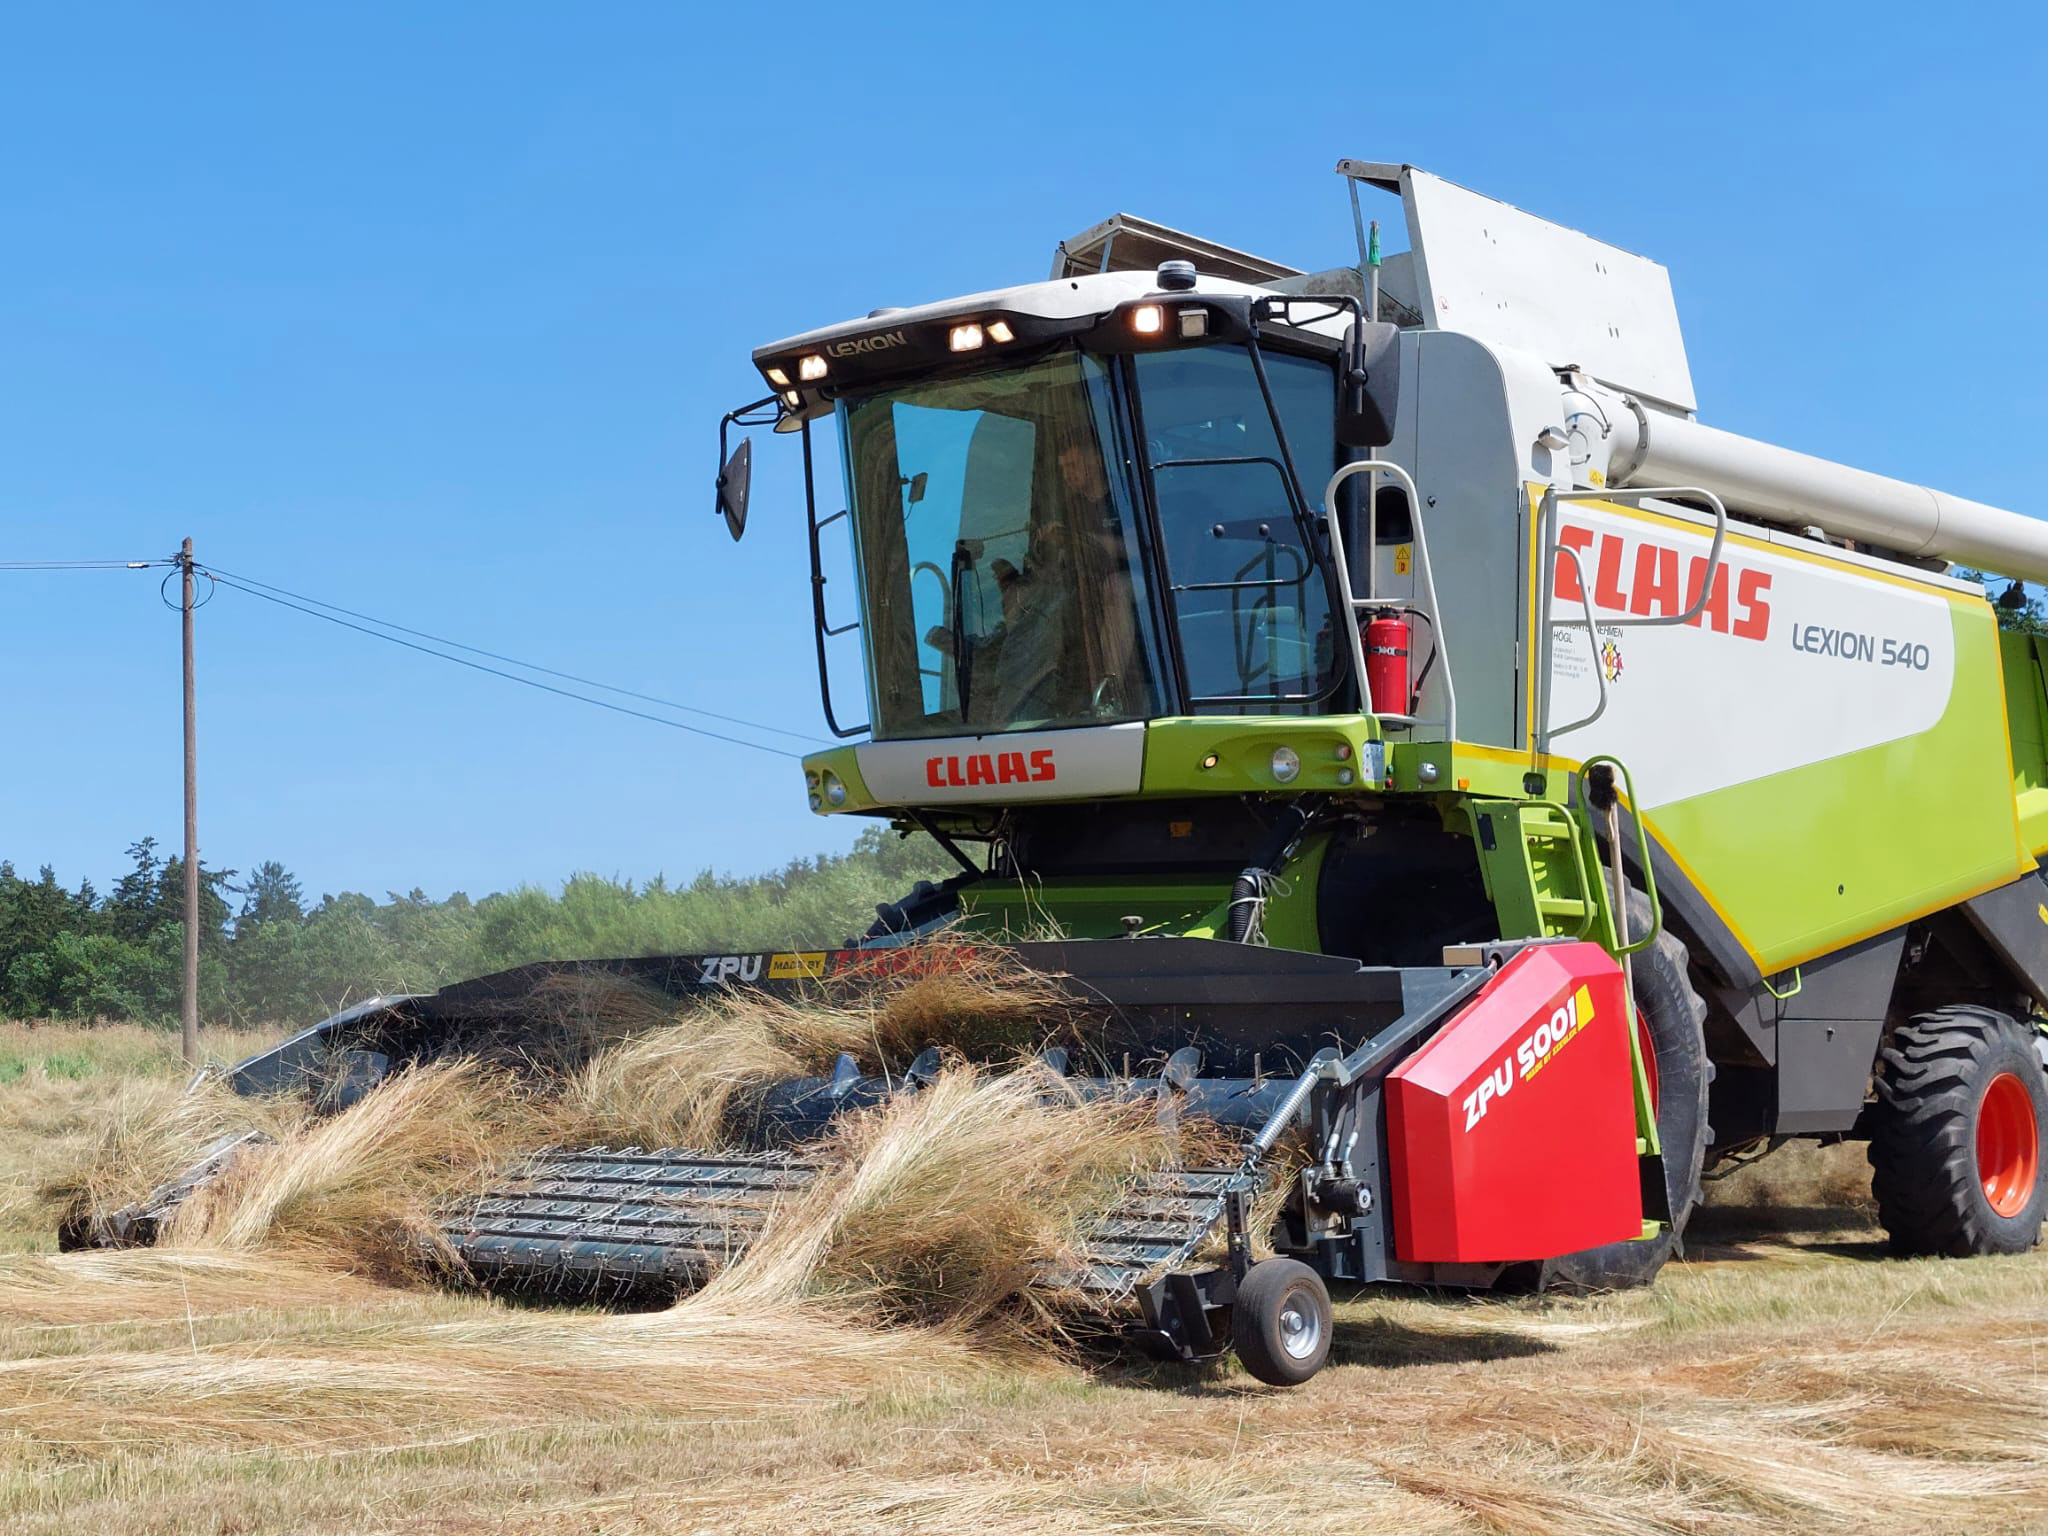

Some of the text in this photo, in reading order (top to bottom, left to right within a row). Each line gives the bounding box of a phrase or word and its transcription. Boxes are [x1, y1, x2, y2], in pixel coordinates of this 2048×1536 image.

[826, 331, 908, 358] LEXION
[1553, 524, 1773, 643] CLAAS
[1792, 622, 1930, 672] LEXION 540
[926, 749, 1056, 788] CLAAS
[698, 954, 763, 985] ZPU
[1462, 1056, 1514, 1134] ZPU
[1516, 994, 1577, 1079] 5001
